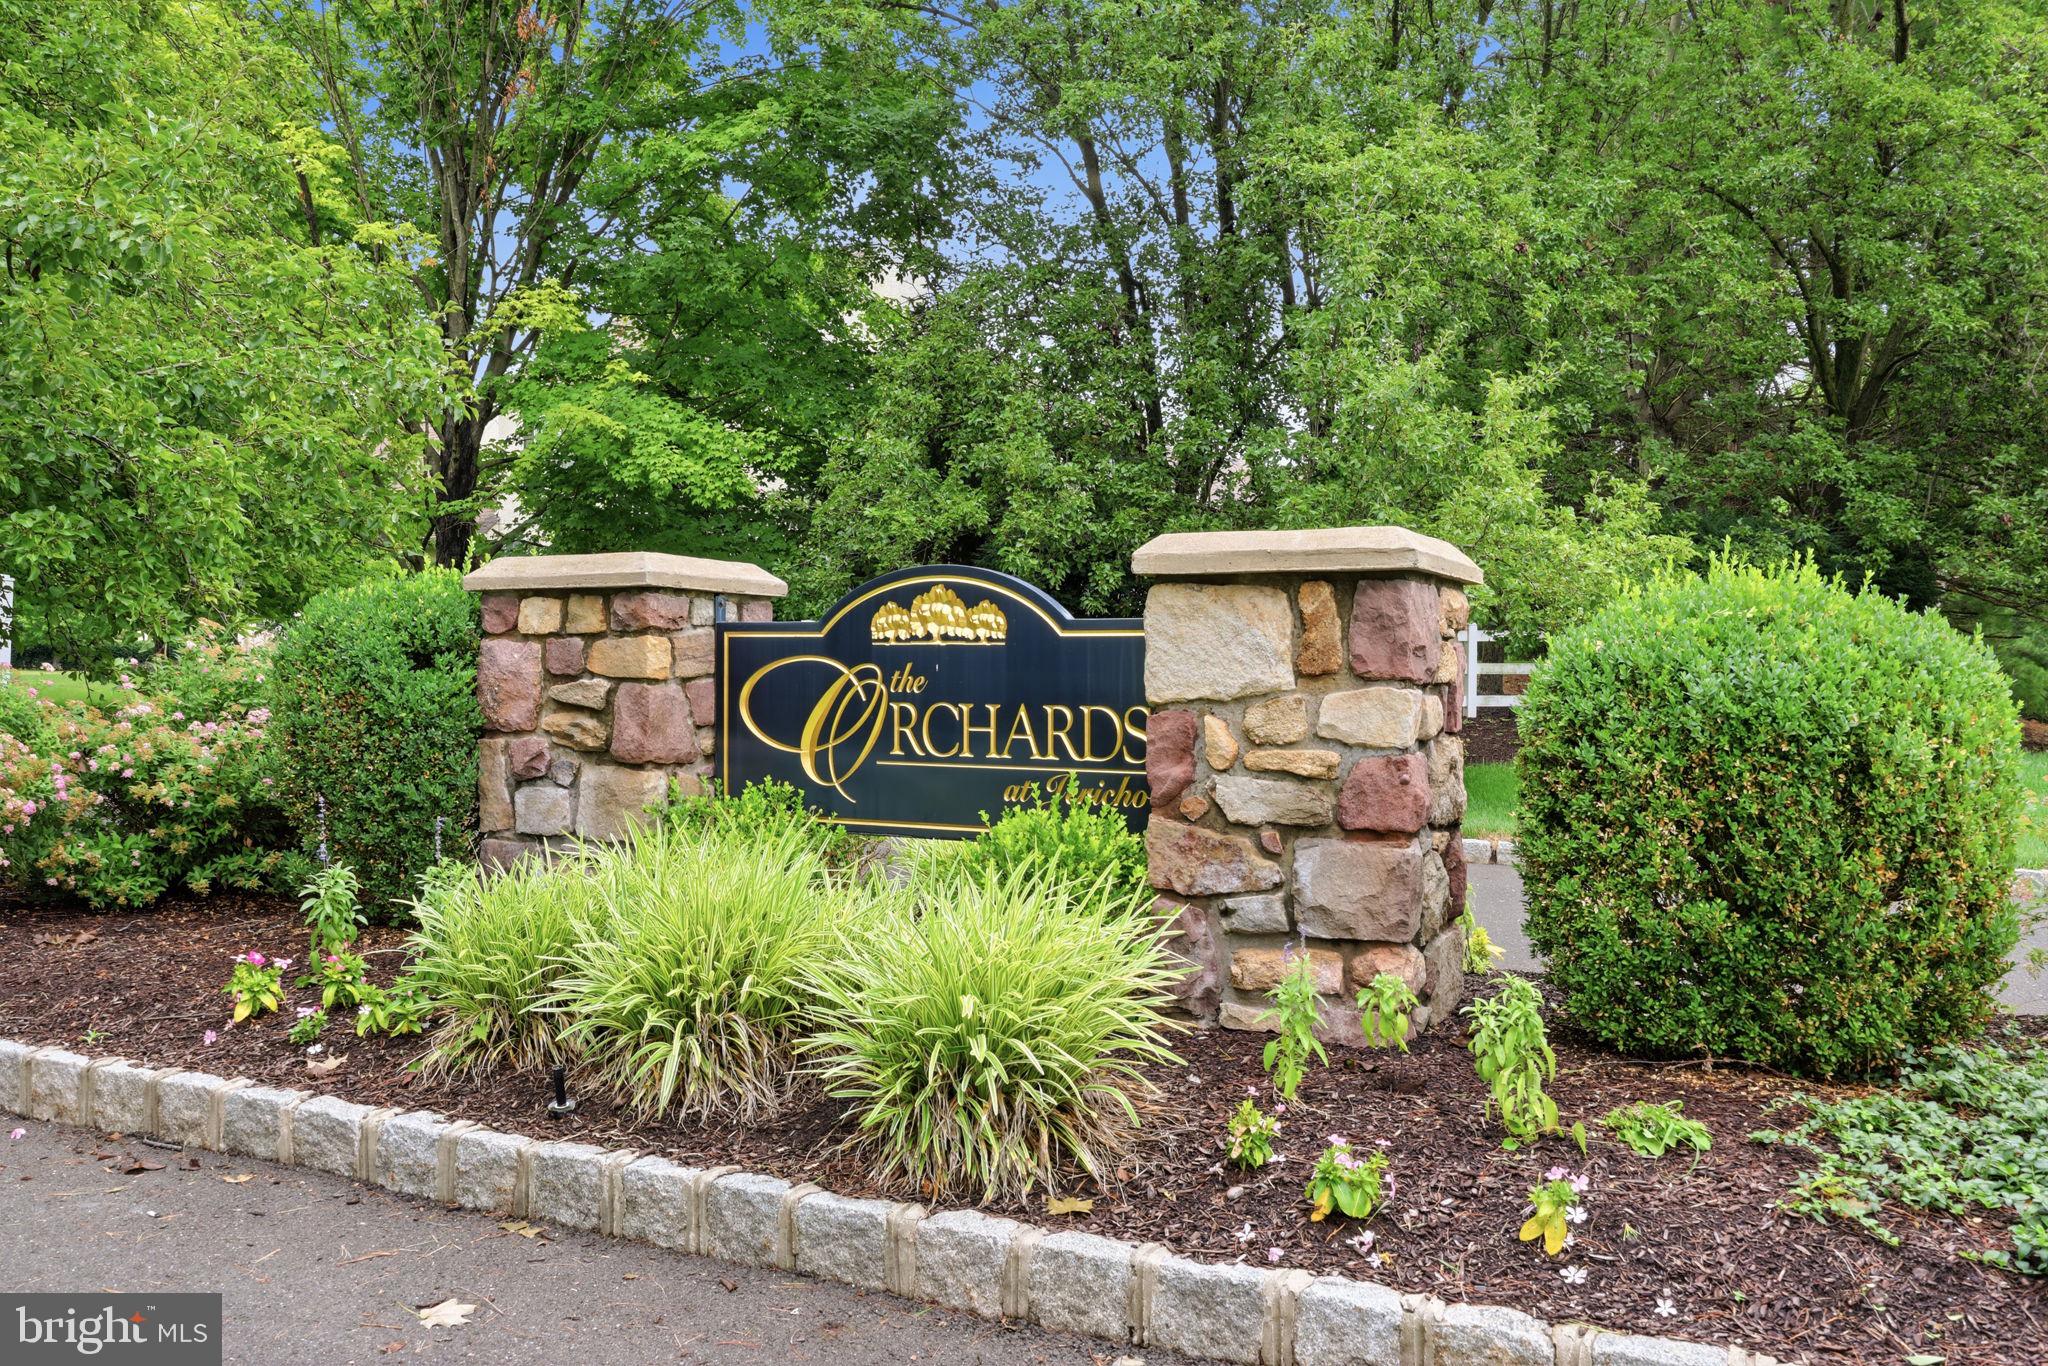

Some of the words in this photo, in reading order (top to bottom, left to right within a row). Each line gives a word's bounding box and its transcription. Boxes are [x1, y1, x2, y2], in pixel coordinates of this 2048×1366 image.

[890, 662, 928, 694] the
[739, 655, 1149, 803] ORCHARDS
[1003, 780, 1035, 803] at
